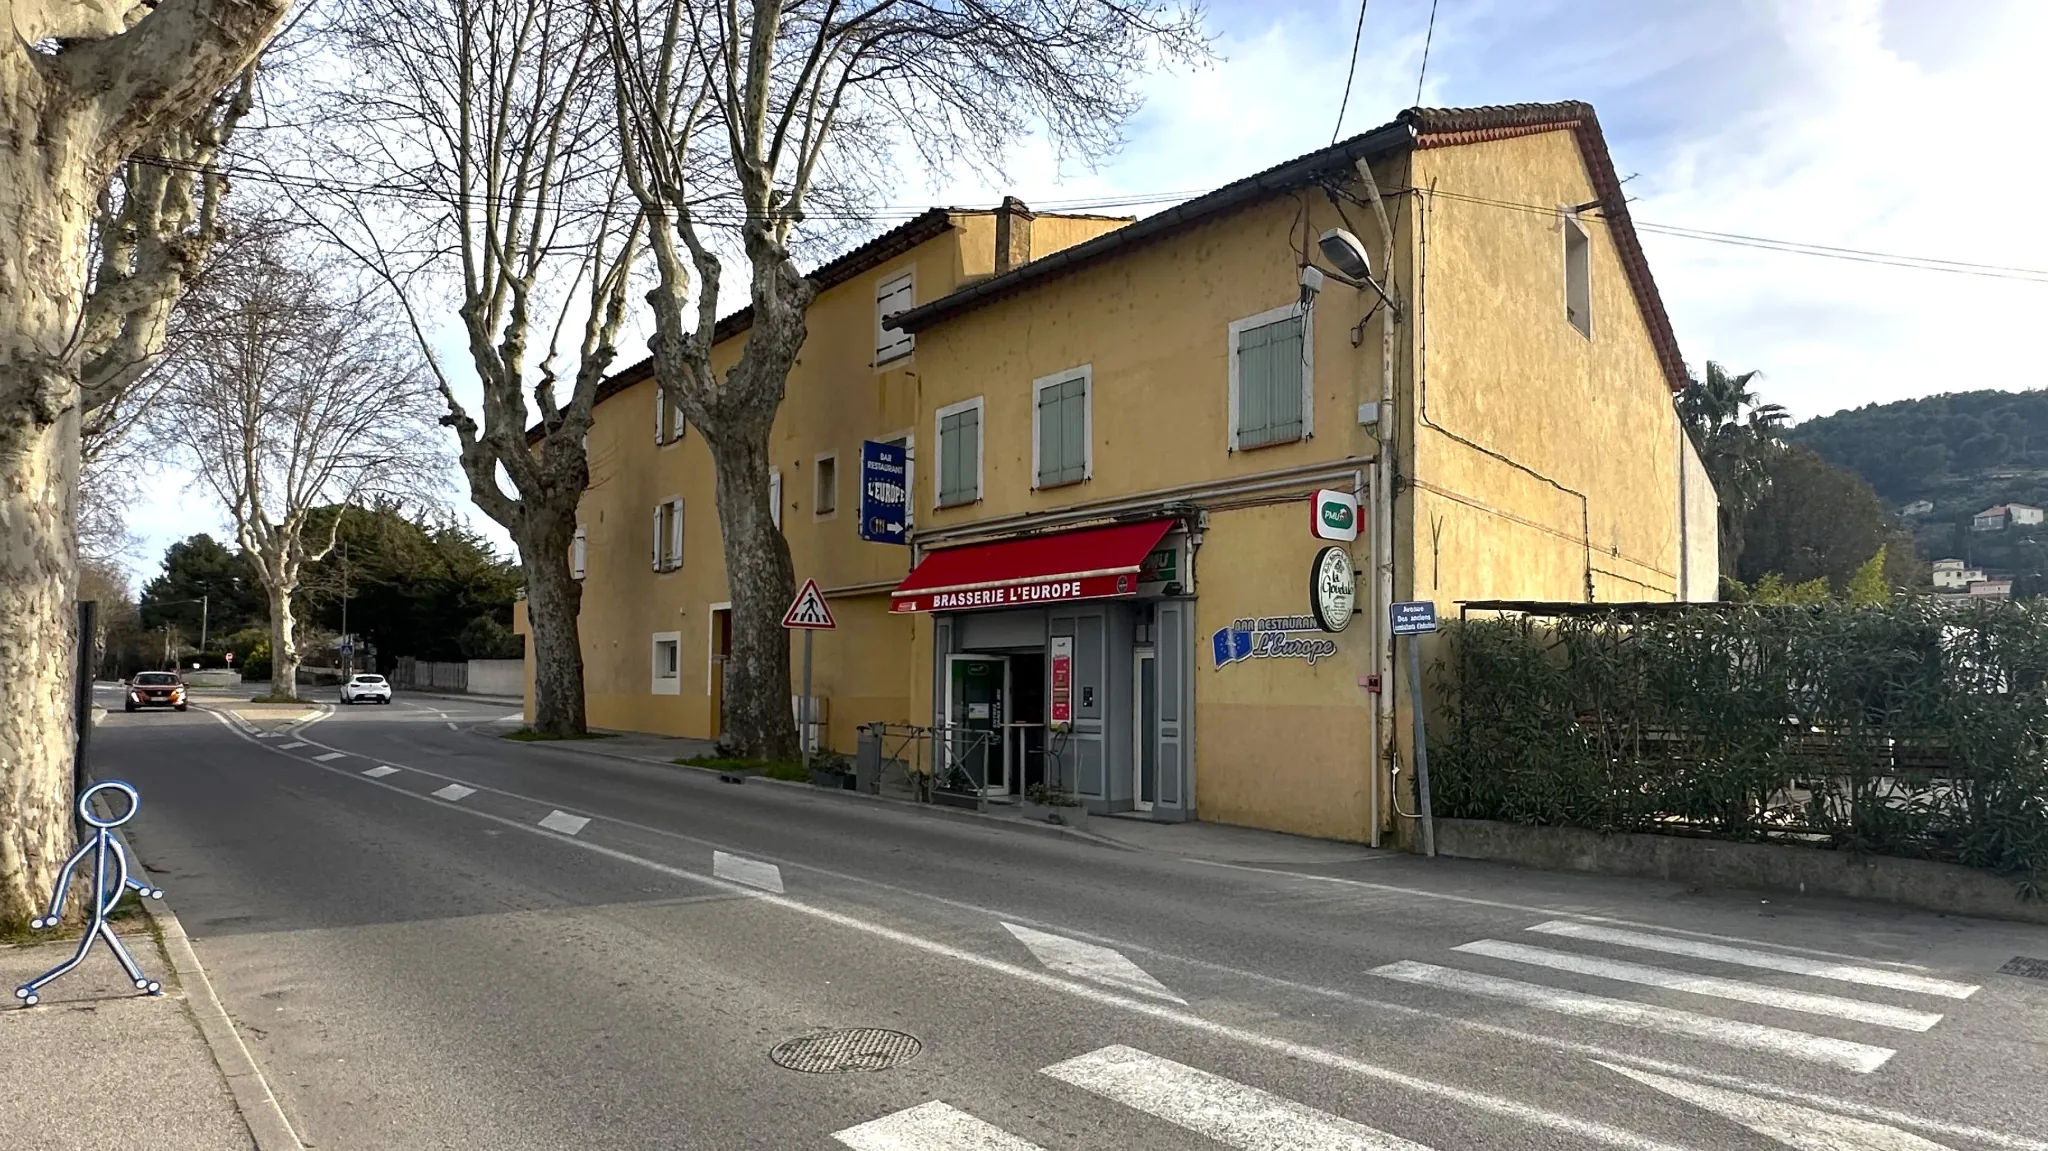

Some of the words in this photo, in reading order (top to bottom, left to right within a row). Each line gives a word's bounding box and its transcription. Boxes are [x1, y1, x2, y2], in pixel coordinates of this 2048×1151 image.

[880, 452, 892, 461] BAR
[867, 460, 903, 474] RESTAURANT
[868, 481, 906, 503] L'EUROPE
[1324, 509, 1340, 521] PMU
[933, 587, 1005, 608] BRASSERIE
[1009, 581, 1081, 601] L'EUROPE
[1233, 619, 1255, 631] BAR
[1258, 617, 1318, 631] RESTAURAN
[1410, 613, 1431, 622] anciens
[1253, 631, 1335, 661] L'Europe
